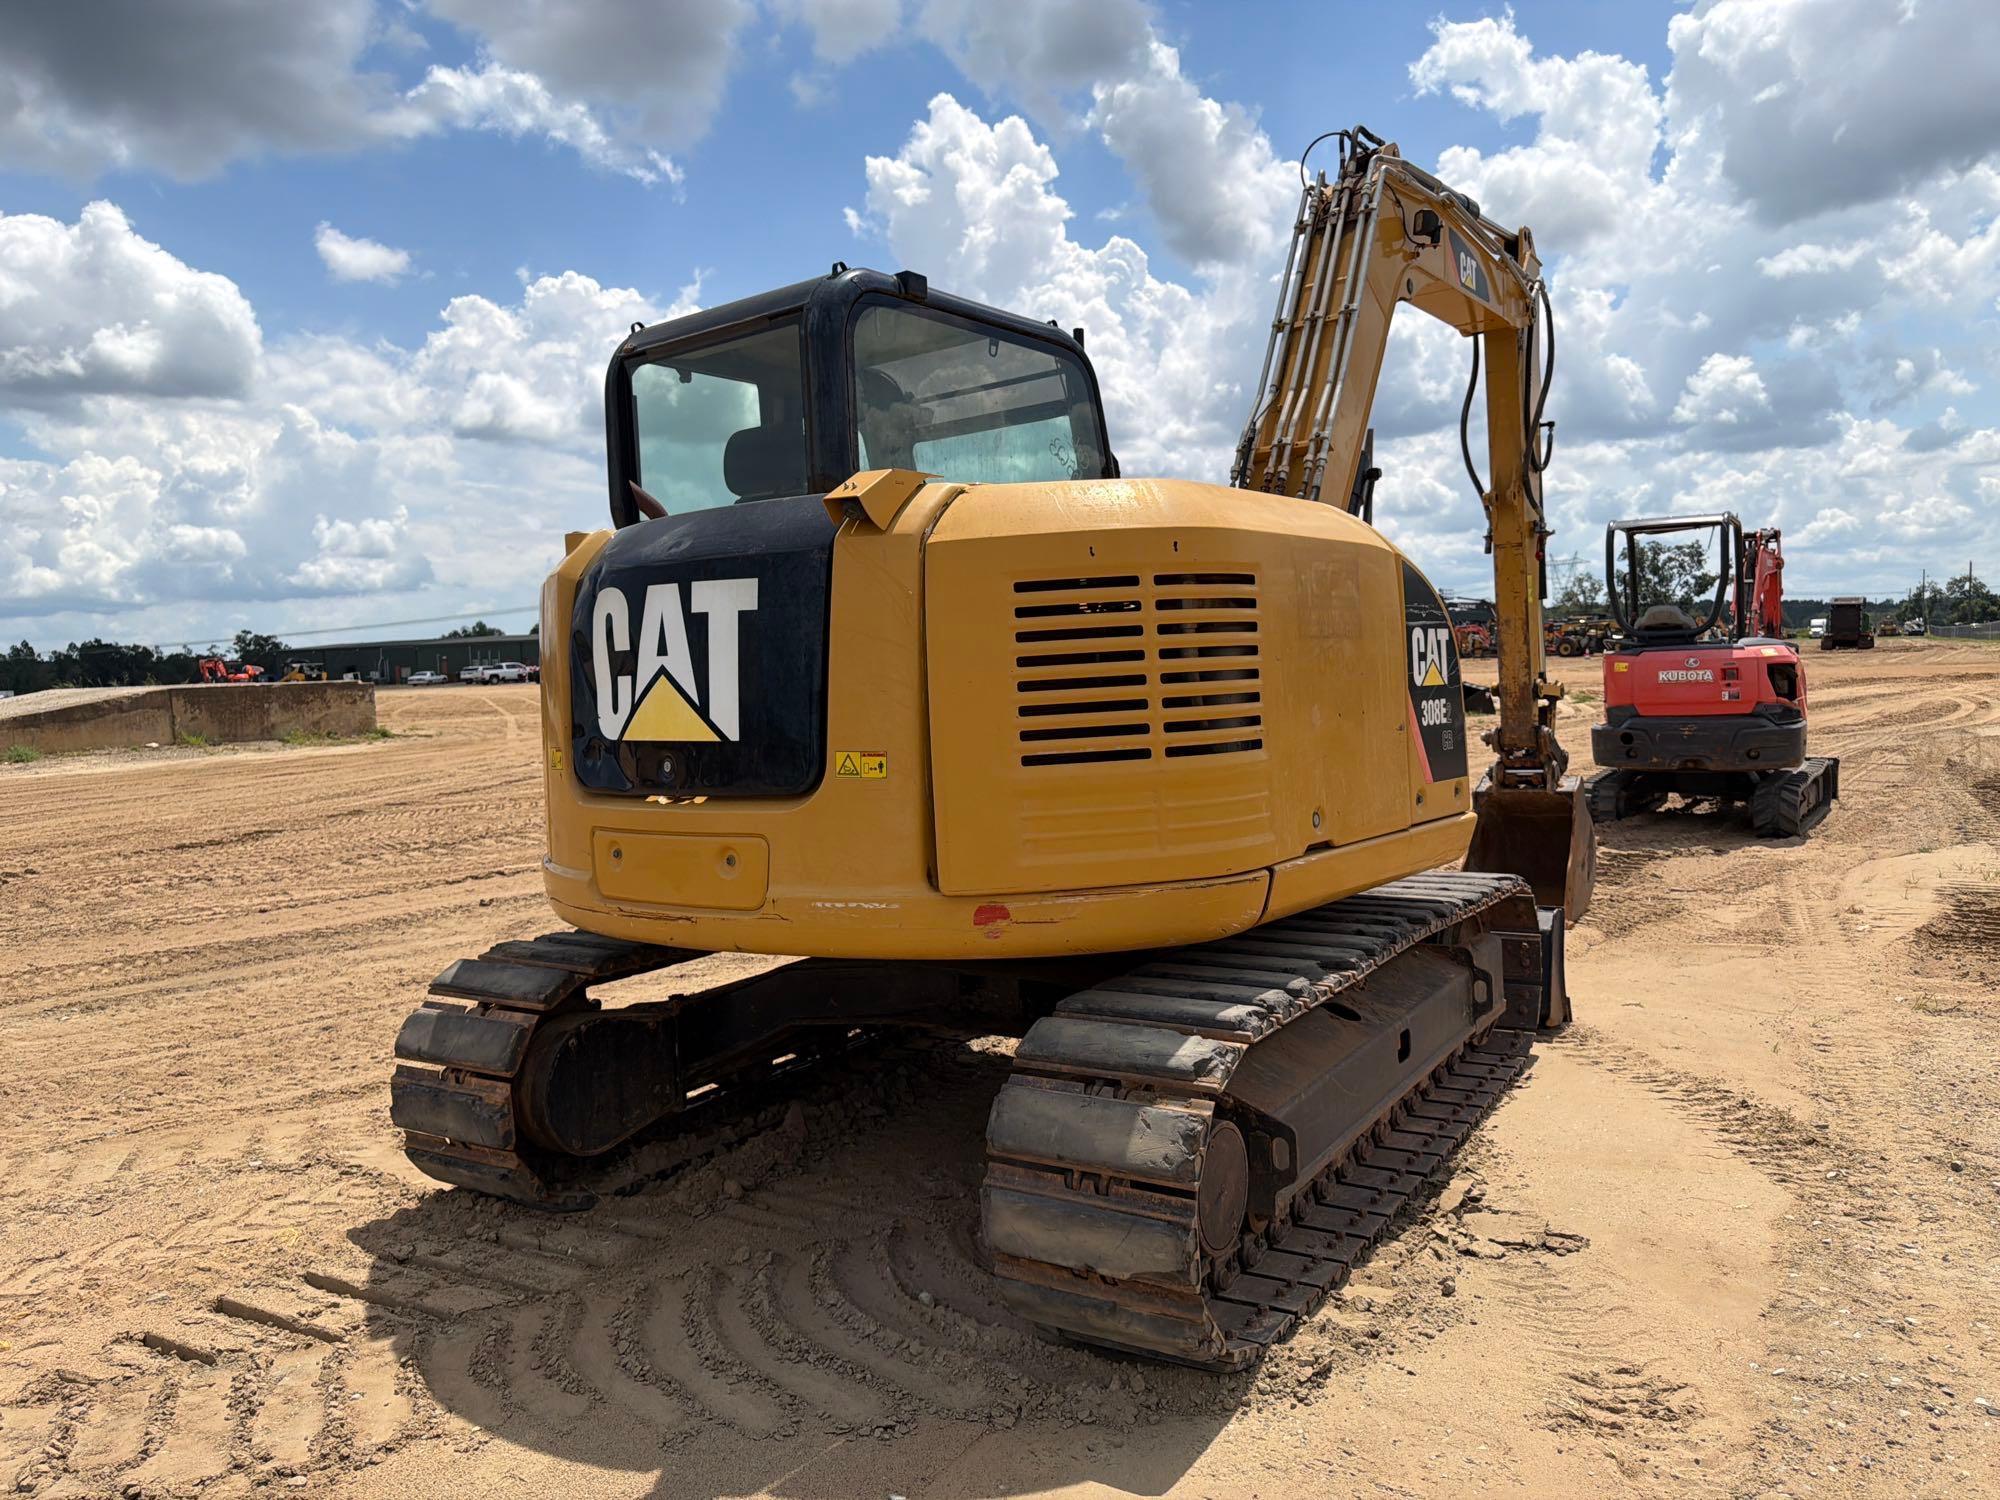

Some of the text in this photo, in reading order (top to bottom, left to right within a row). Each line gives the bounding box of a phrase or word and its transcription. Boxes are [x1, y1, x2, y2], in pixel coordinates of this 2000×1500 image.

[1460, 252, 1477, 290] CAT
[592, 578, 758, 742] CAT
[1412, 626, 1449, 687] CAT
[1658, 669, 1713, 682] KUBOTA
